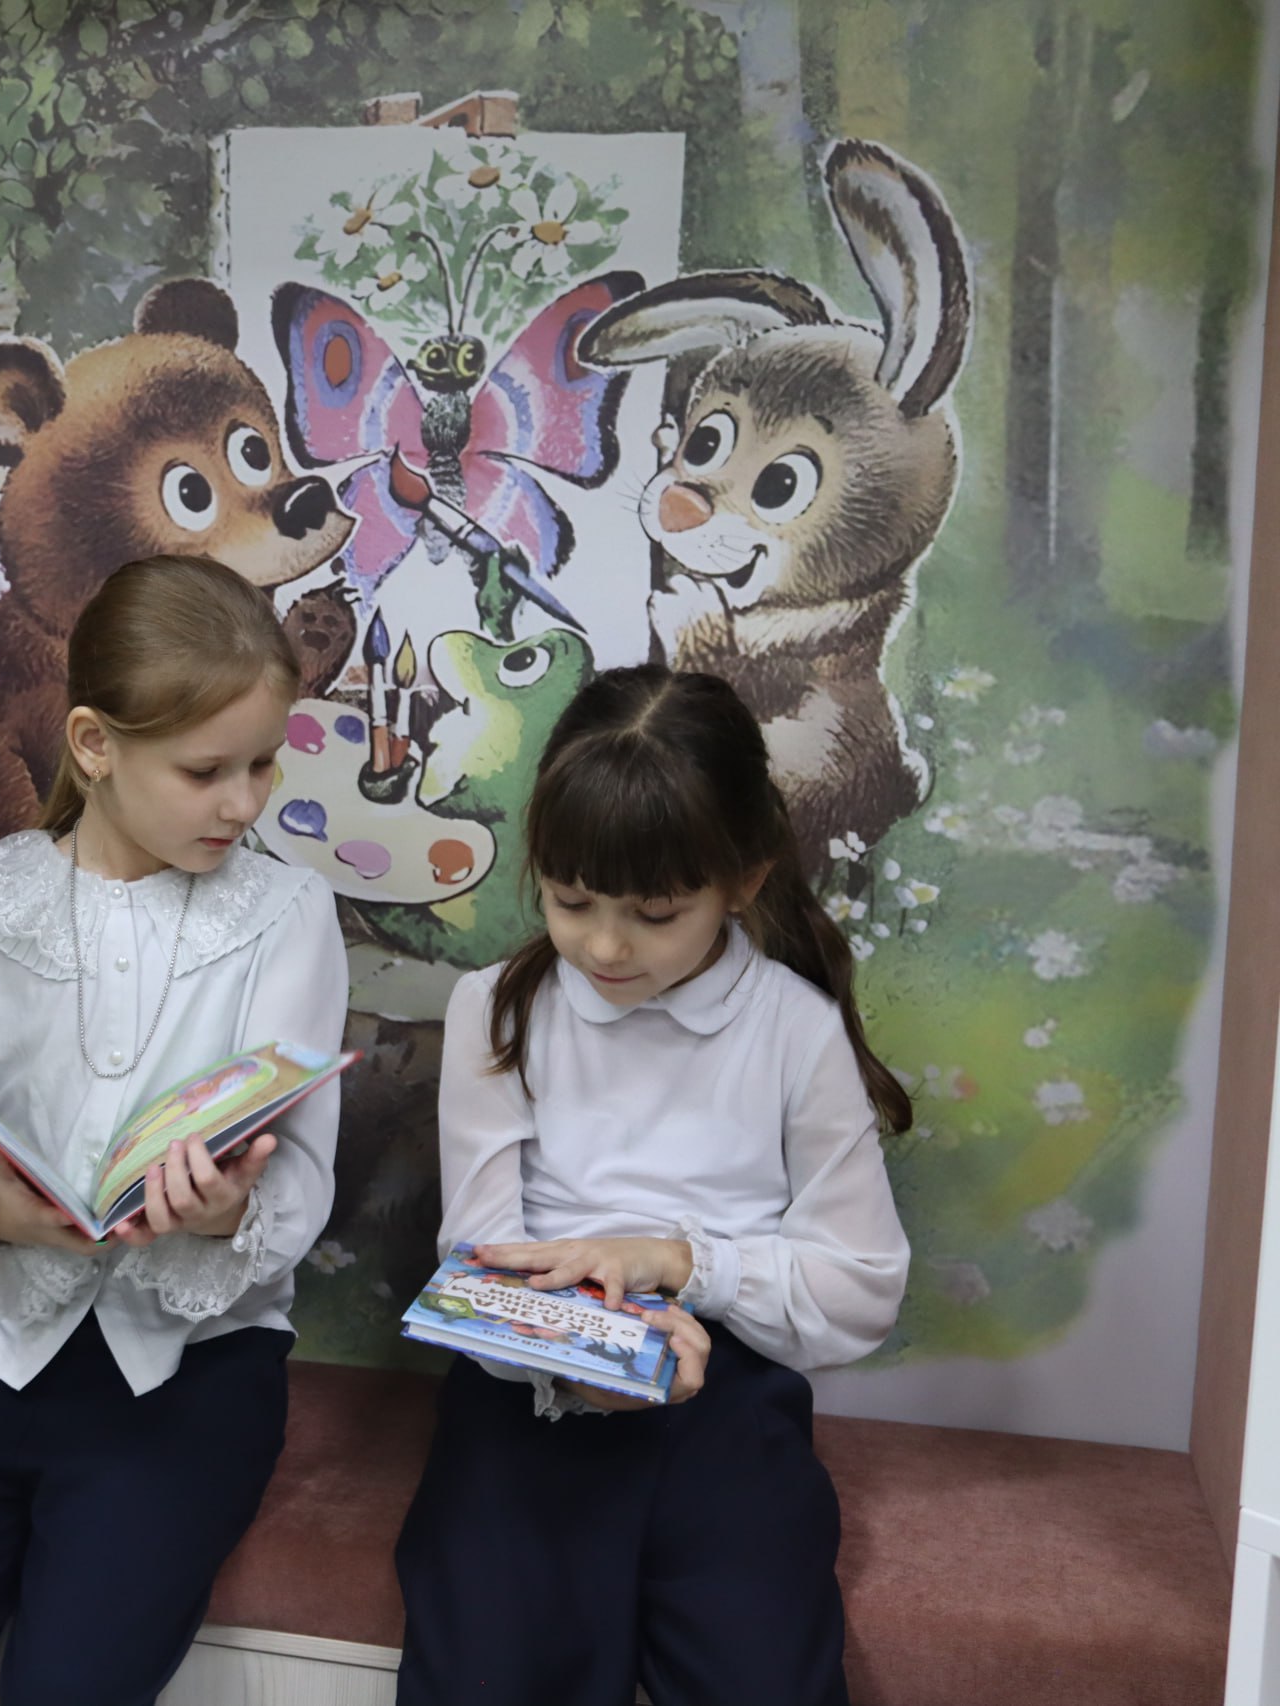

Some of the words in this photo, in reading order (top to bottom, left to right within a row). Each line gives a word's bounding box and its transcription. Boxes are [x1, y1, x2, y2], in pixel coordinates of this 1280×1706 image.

[451, 1284, 612, 1331] ПОТЕРЯННОМ
[474, 1298, 609, 1338] СКАЗКА
[488, 1288, 604, 1322] ВРЕМЕНИ
